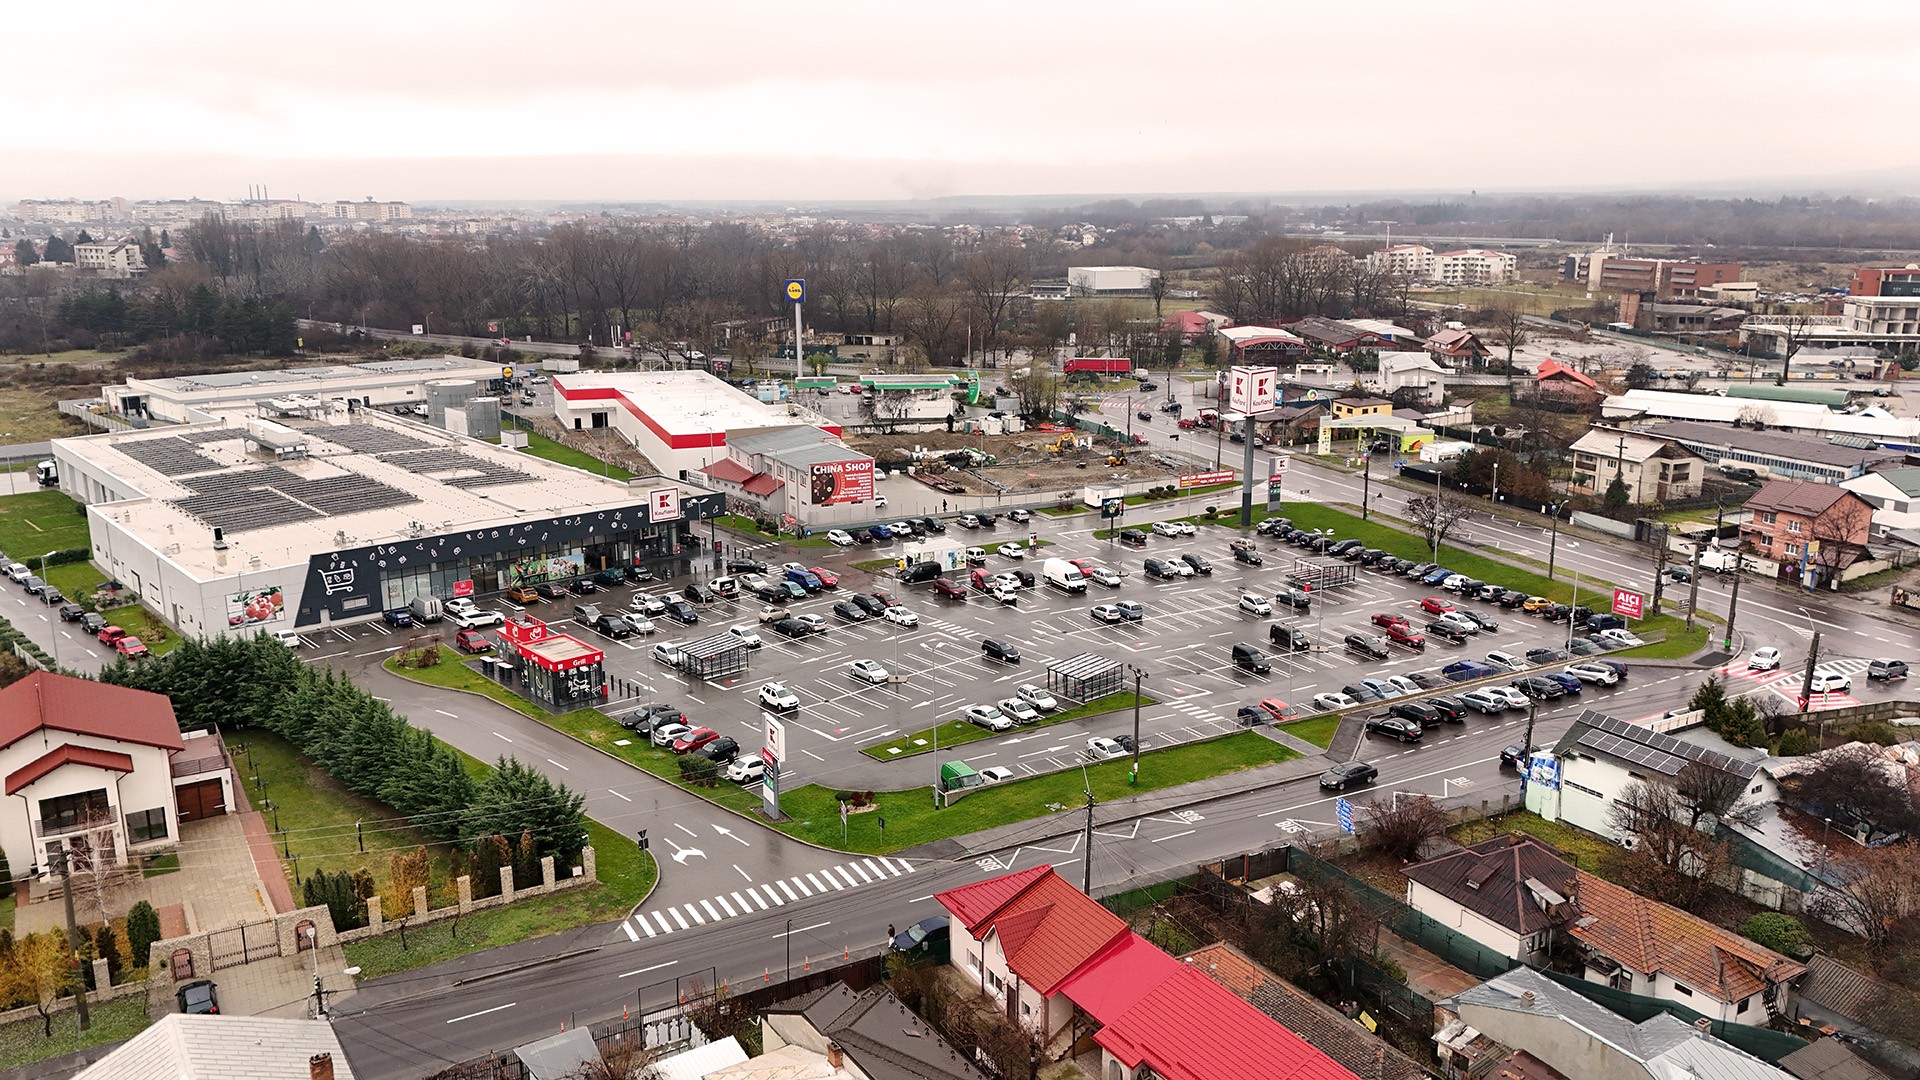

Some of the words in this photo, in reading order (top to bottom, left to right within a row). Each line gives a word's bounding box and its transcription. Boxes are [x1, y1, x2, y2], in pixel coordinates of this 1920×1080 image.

[1258, 378, 1269, 396] K
[813, 464, 843, 475] CHINA
[845, 462, 871, 472] SHOP
[660, 495, 670, 508] K
[654, 508, 676, 516] Kaufland
[1617, 592, 1640, 606] AICI
[573, 658, 586, 666] Grill
[1178, 810, 1206, 822] BUS
[1274, 821, 1303, 834] BUS
[975, 858, 1002, 872] BUS
